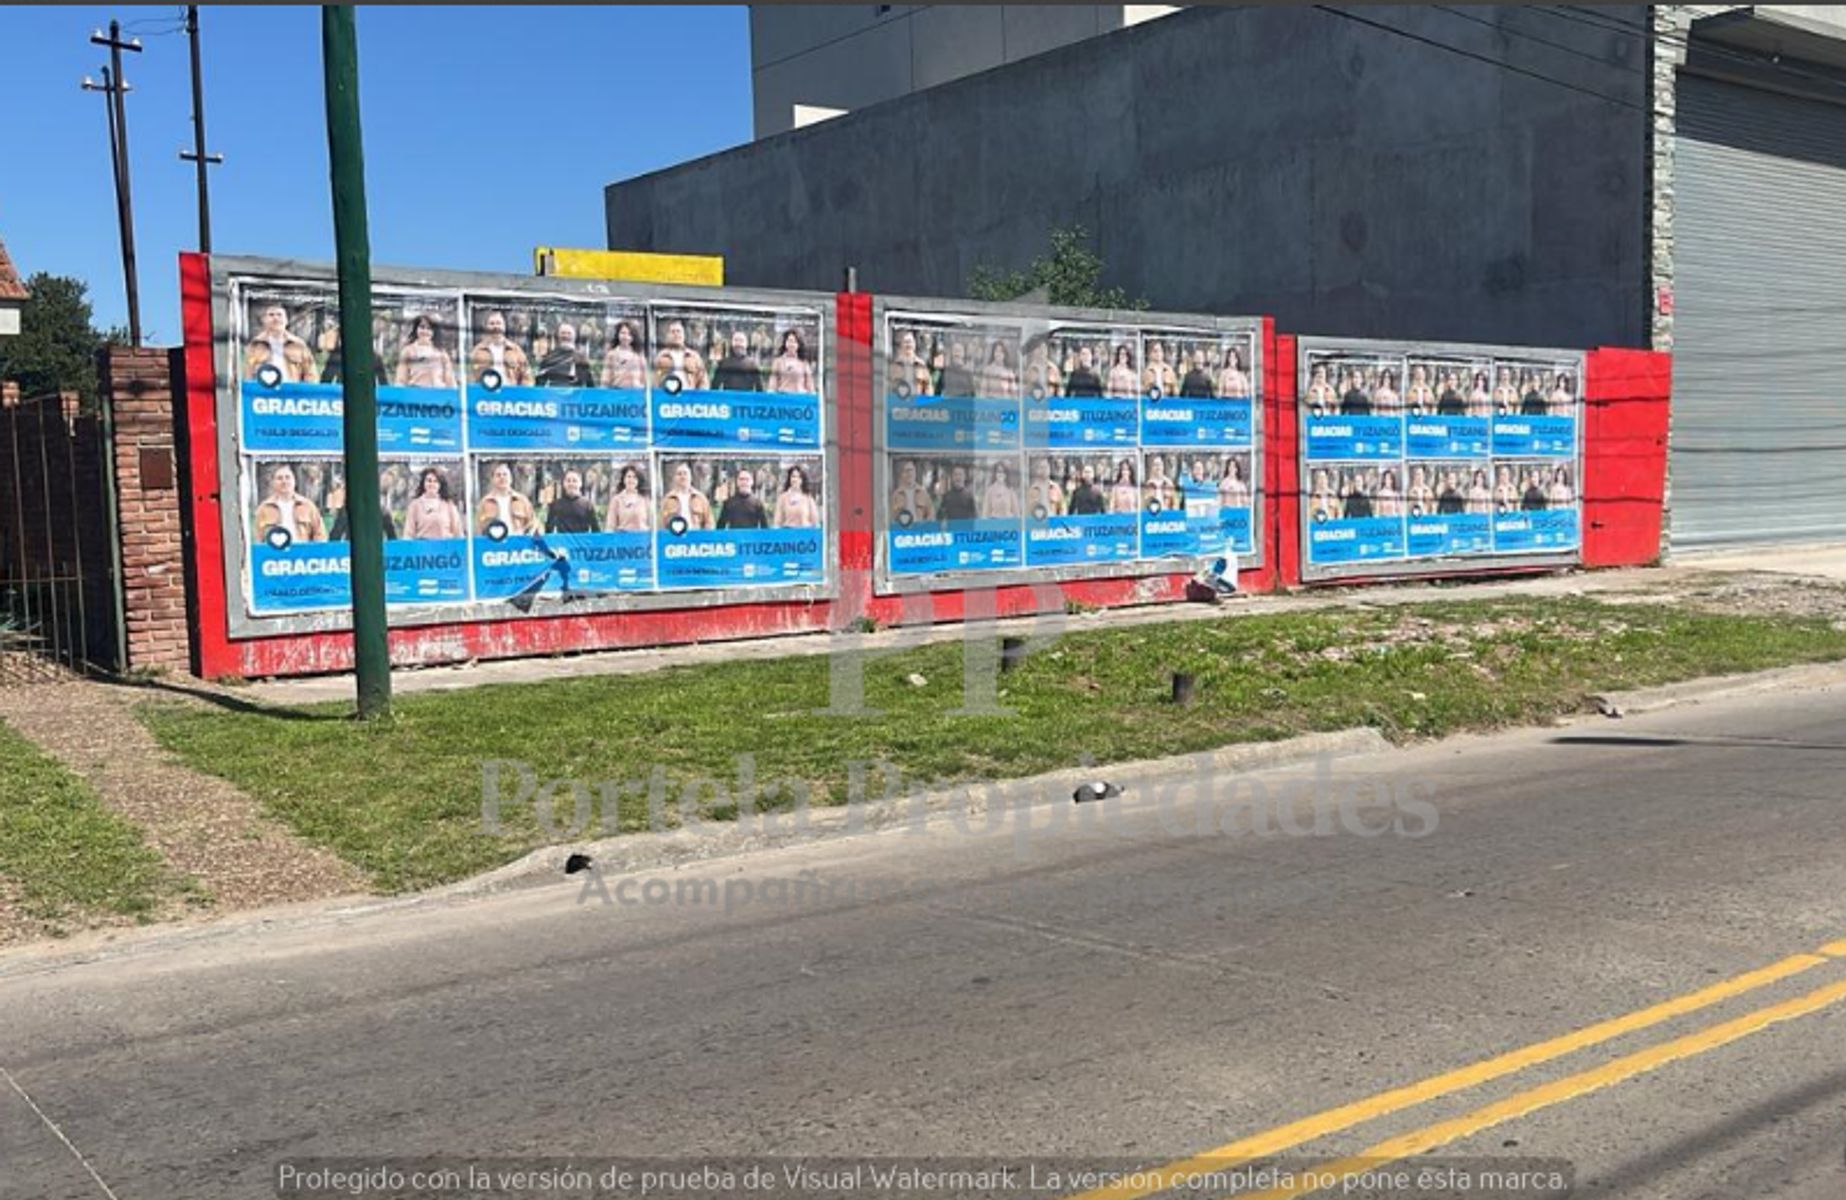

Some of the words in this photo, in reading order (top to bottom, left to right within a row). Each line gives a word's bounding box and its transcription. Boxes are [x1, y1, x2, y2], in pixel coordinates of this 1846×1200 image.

[252, 397, 344, 416] GRACIAS
[377, 401, 456, 418] ZAINGÓ
[476, 400, 557, 418] GRACIAS
[659, 403, 731, 419] GRACIAS
[1028, 408, 1079, 422] GRACIAS
[1145, 408, 1193, 421] GRACIAS
[894, 532, 953, 548] GRACIAS
[664, 542, 736, 558] GRACIAS
[262, 556, 351, 576] GRACIAS
[385, 552, 461, 572] ZAINGÓ
